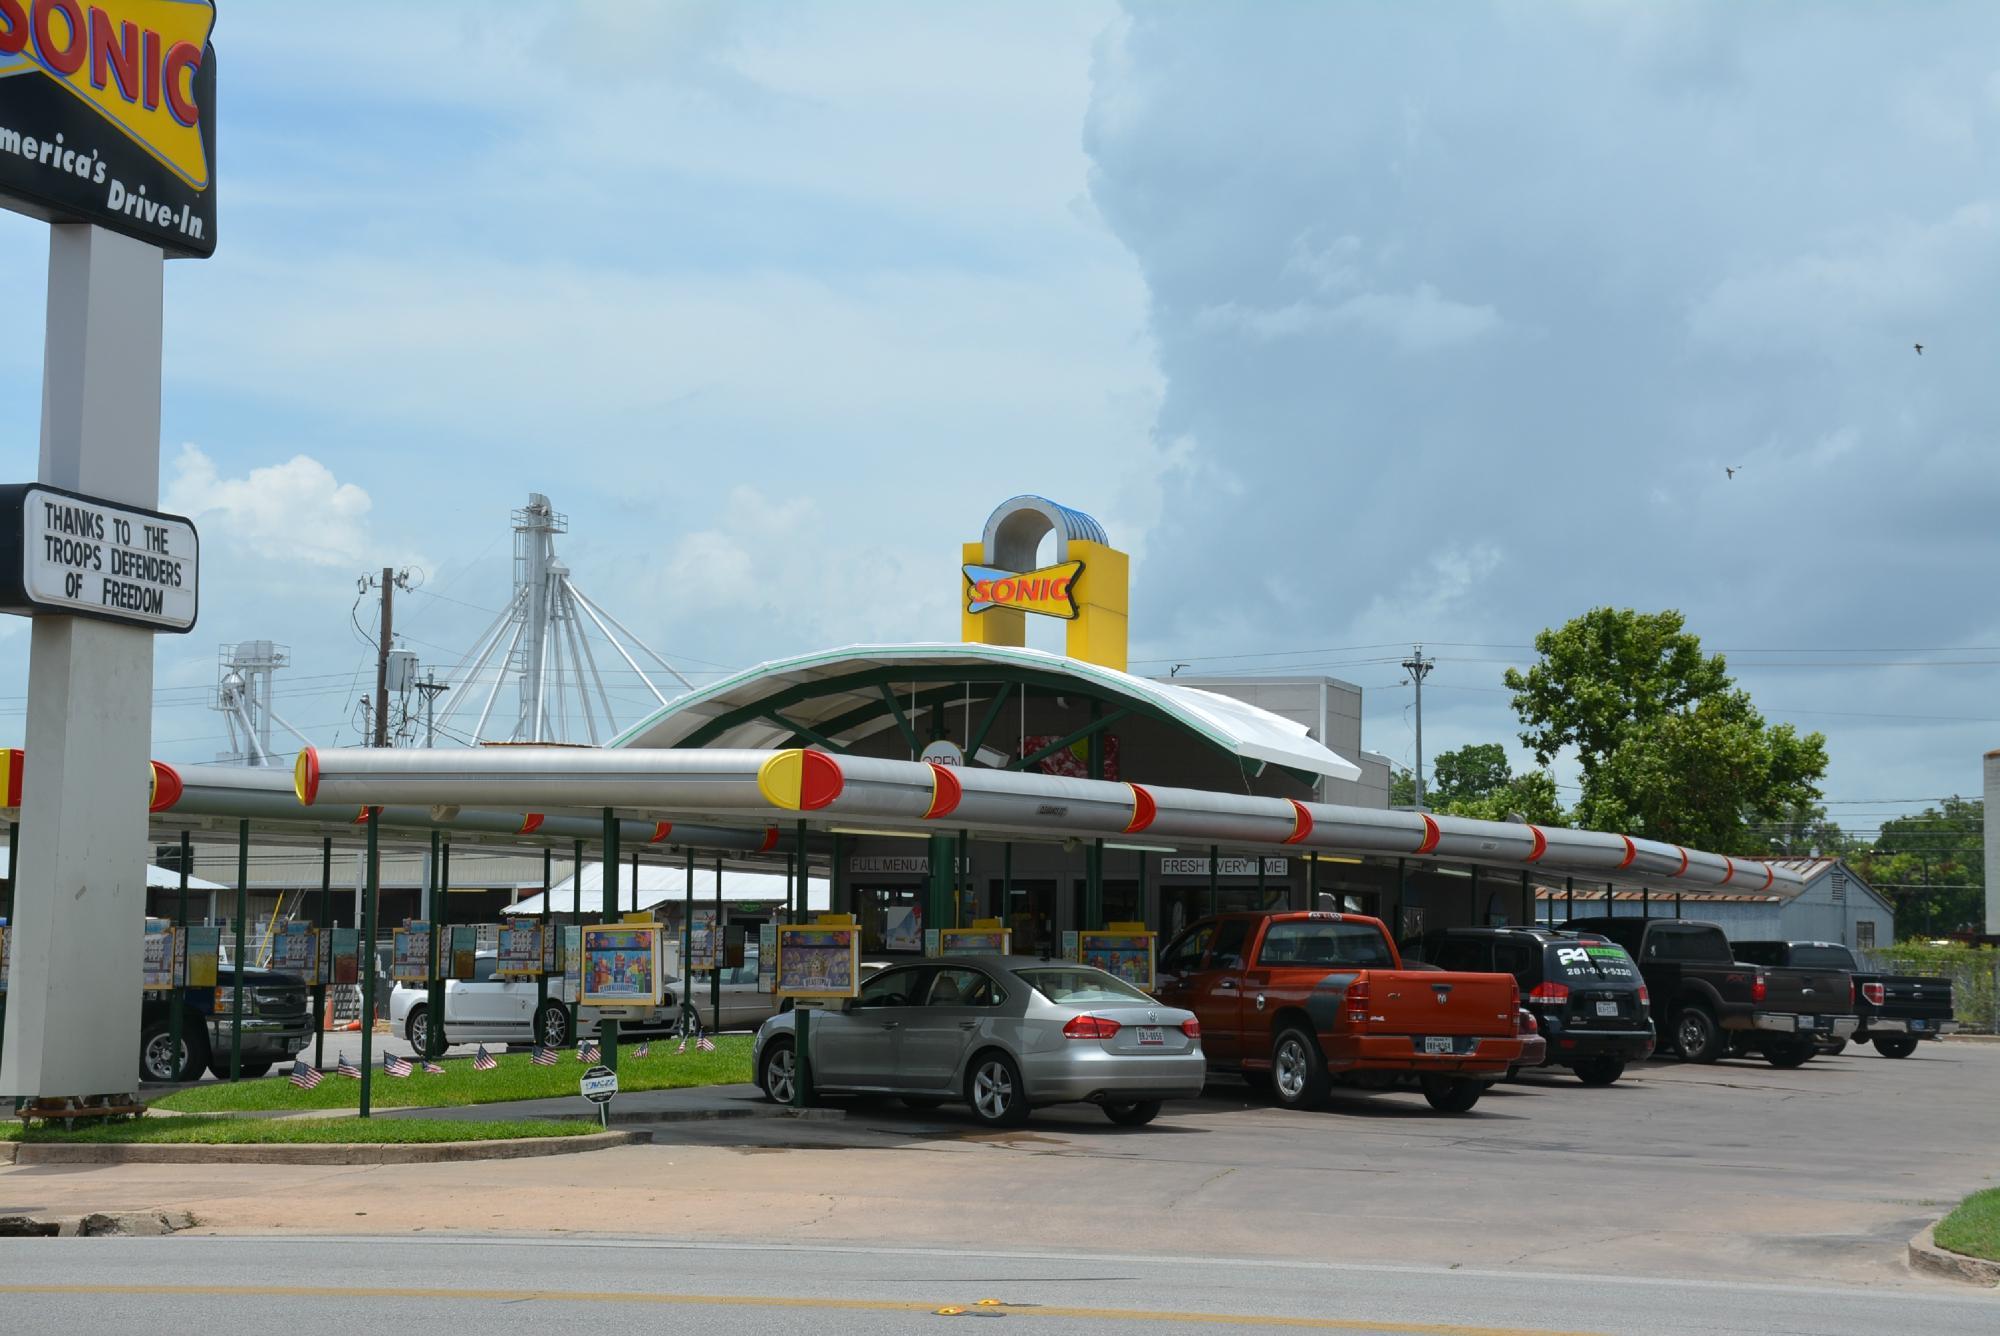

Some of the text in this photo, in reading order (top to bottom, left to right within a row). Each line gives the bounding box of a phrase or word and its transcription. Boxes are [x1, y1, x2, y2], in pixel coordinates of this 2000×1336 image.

[44, 502, 169, 554] THANKS TO THE
[44, 535, 182, 587] TROOPS DEFENDERS
[65, 572, 163, 615] OF FREEDOM
[973, 577, 1071, 603] SONIC
[852, 859, 880, 872] FULL
[883, 859, 918, 872] MENU
[1163, 859, 1205, 873] FRESH
[1252, 860, 1286, 873] TME!
